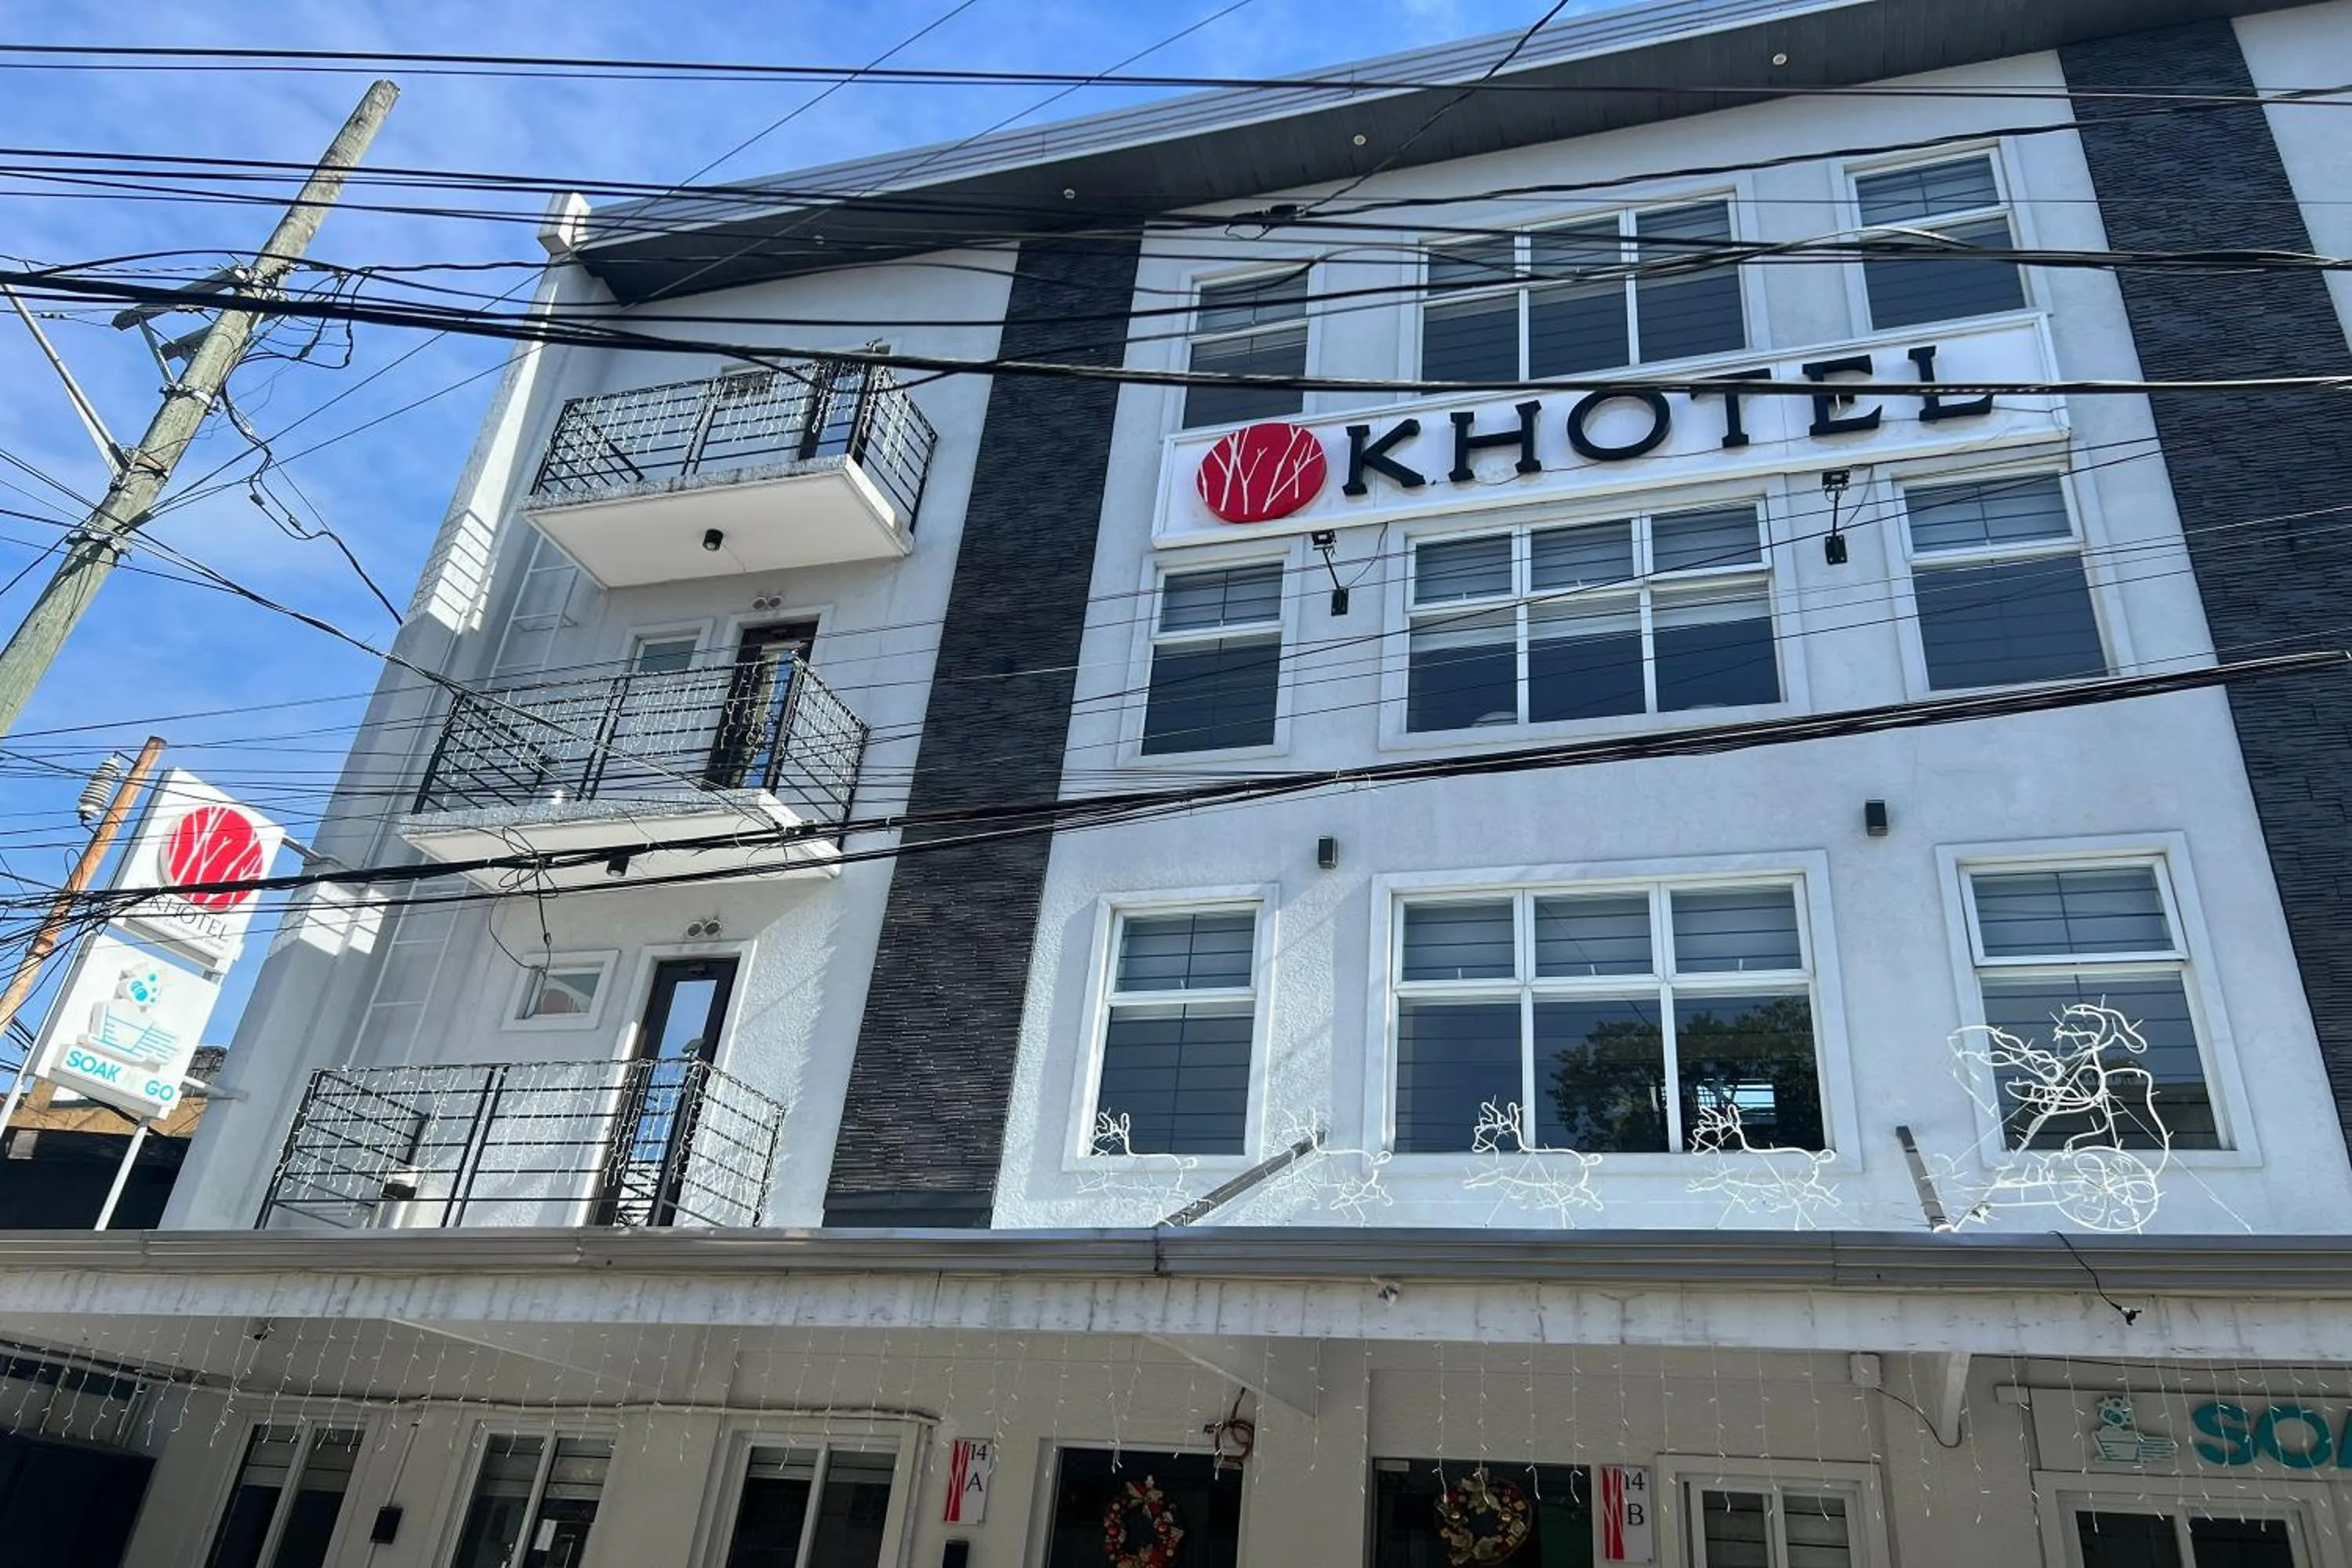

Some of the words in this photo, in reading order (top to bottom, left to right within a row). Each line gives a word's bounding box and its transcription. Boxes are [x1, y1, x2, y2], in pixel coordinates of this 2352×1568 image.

[1342, 345, 1994, 495] KHOTEL
[66, 1050, 122, 1082] SOAK
[144, 1080, 174, 1101] GO
[2191, 1402, 2352, 1469] SO
[971, 1444, 988, 1461] 14
[965, 1471, 984, 1492] A
[1624, 1472, 1646, 1490] 14
[1627, 1503, 1645, 1526] B
